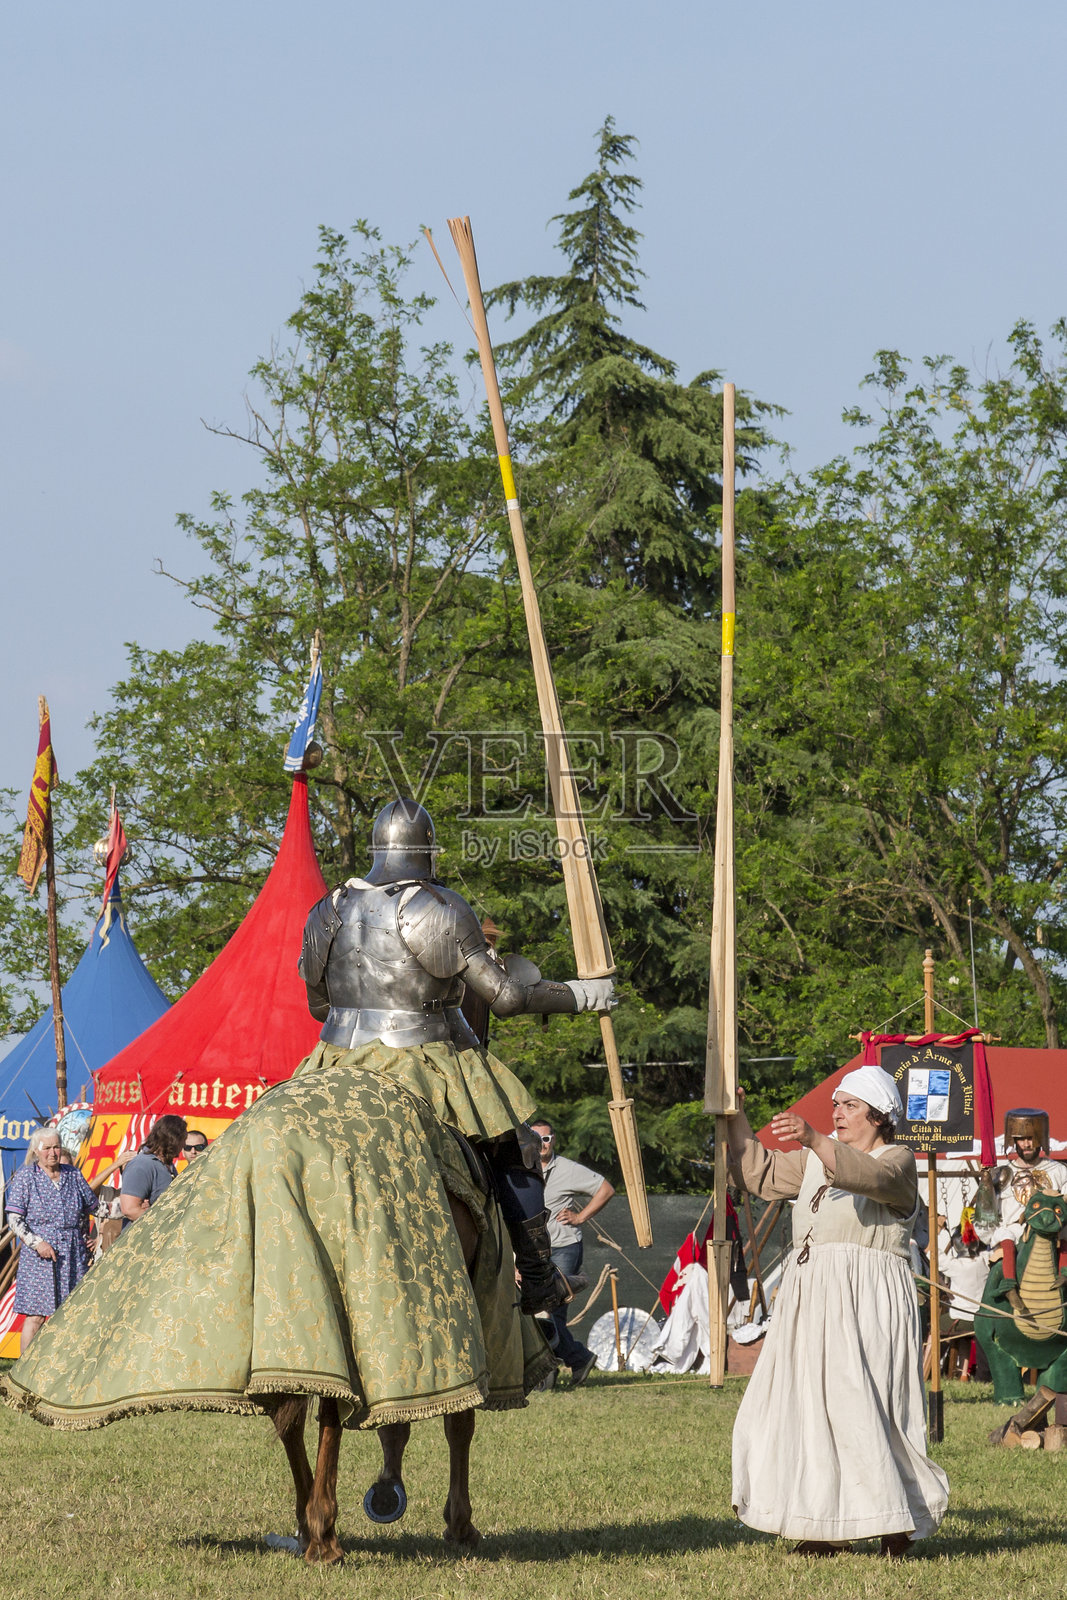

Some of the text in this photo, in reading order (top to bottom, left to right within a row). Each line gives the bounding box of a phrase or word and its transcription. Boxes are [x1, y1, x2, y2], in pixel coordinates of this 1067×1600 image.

[950, 1063, 967, 1083] San
[933, 1125, 942, 1133] di
[930, 1132, 973, 1144] Maggiore
